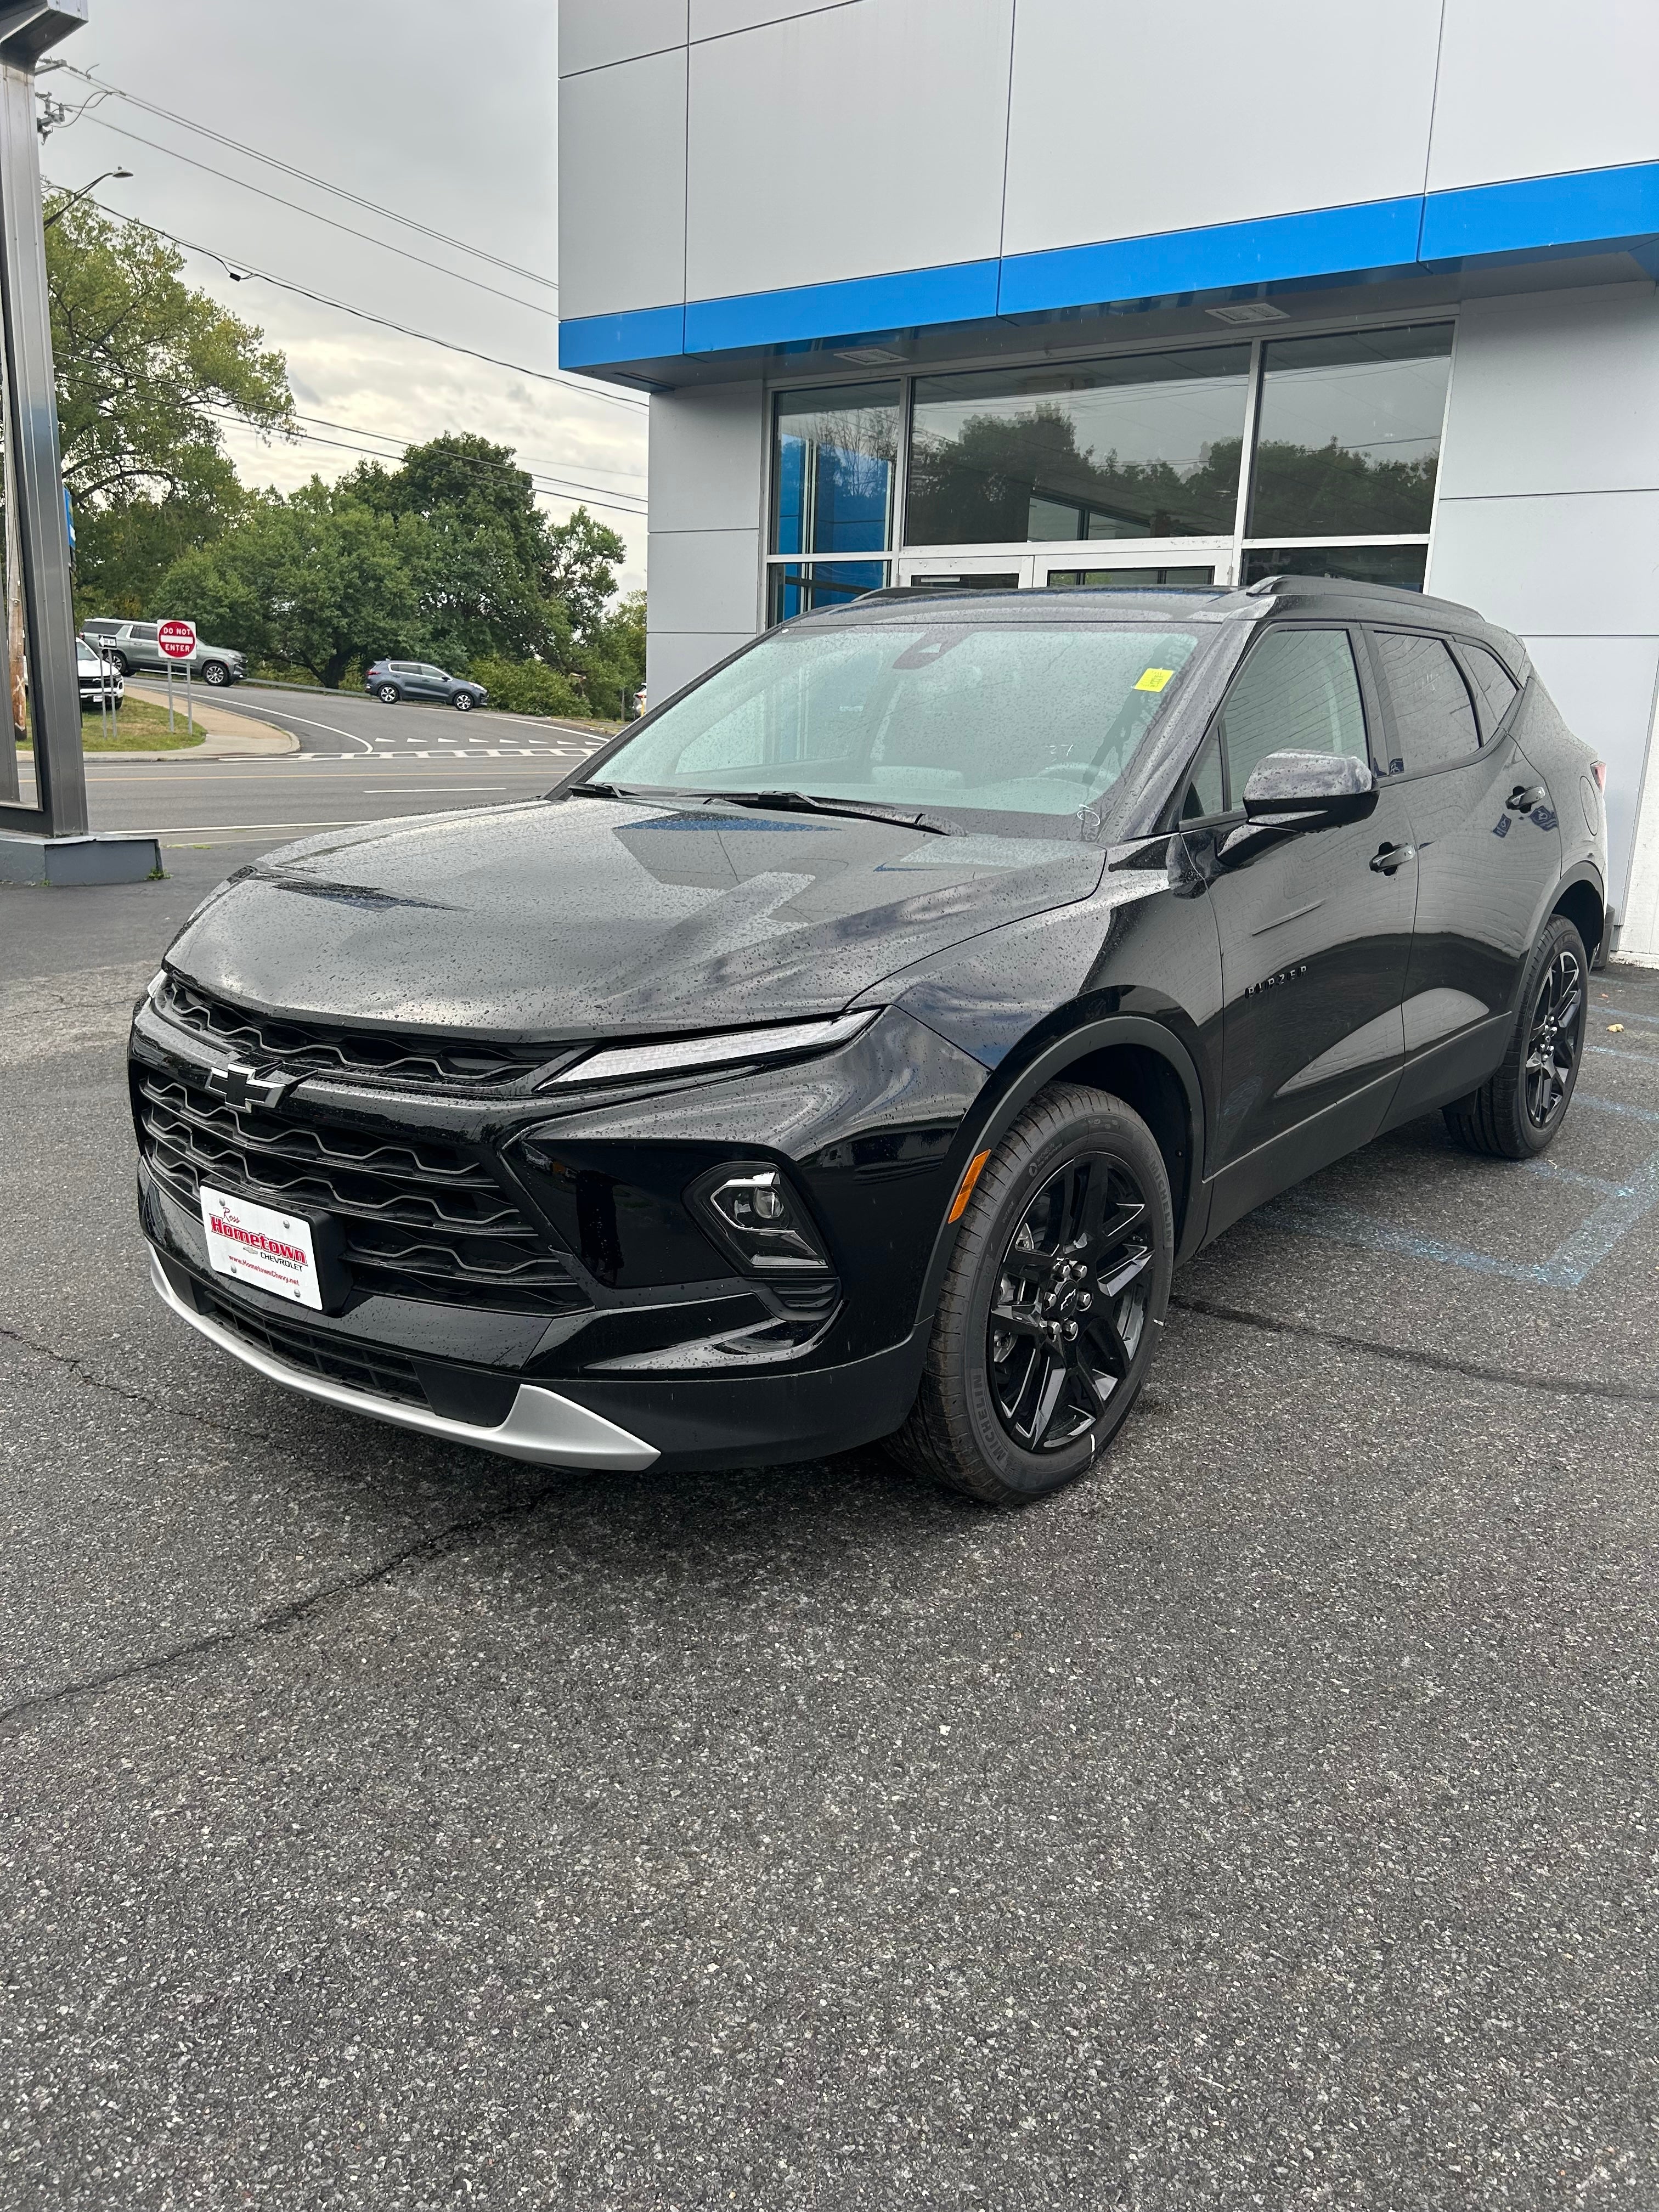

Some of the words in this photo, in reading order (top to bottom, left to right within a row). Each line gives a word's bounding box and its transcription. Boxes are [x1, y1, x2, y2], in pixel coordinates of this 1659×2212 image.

[165, 644, 190, 652] ENTER
[223, 1207, 240, 1223] Ross
[1149, 1159, 1172, 1242] MICHELIN
[210, 1214, 308, 1266] Hometown
[228, 1255, 300, 1286] www.HometownChevy.net
[261, 1252, 303, 1272] CHEVROLET
[973, 1374, 1007, 1462] MICHELIN
